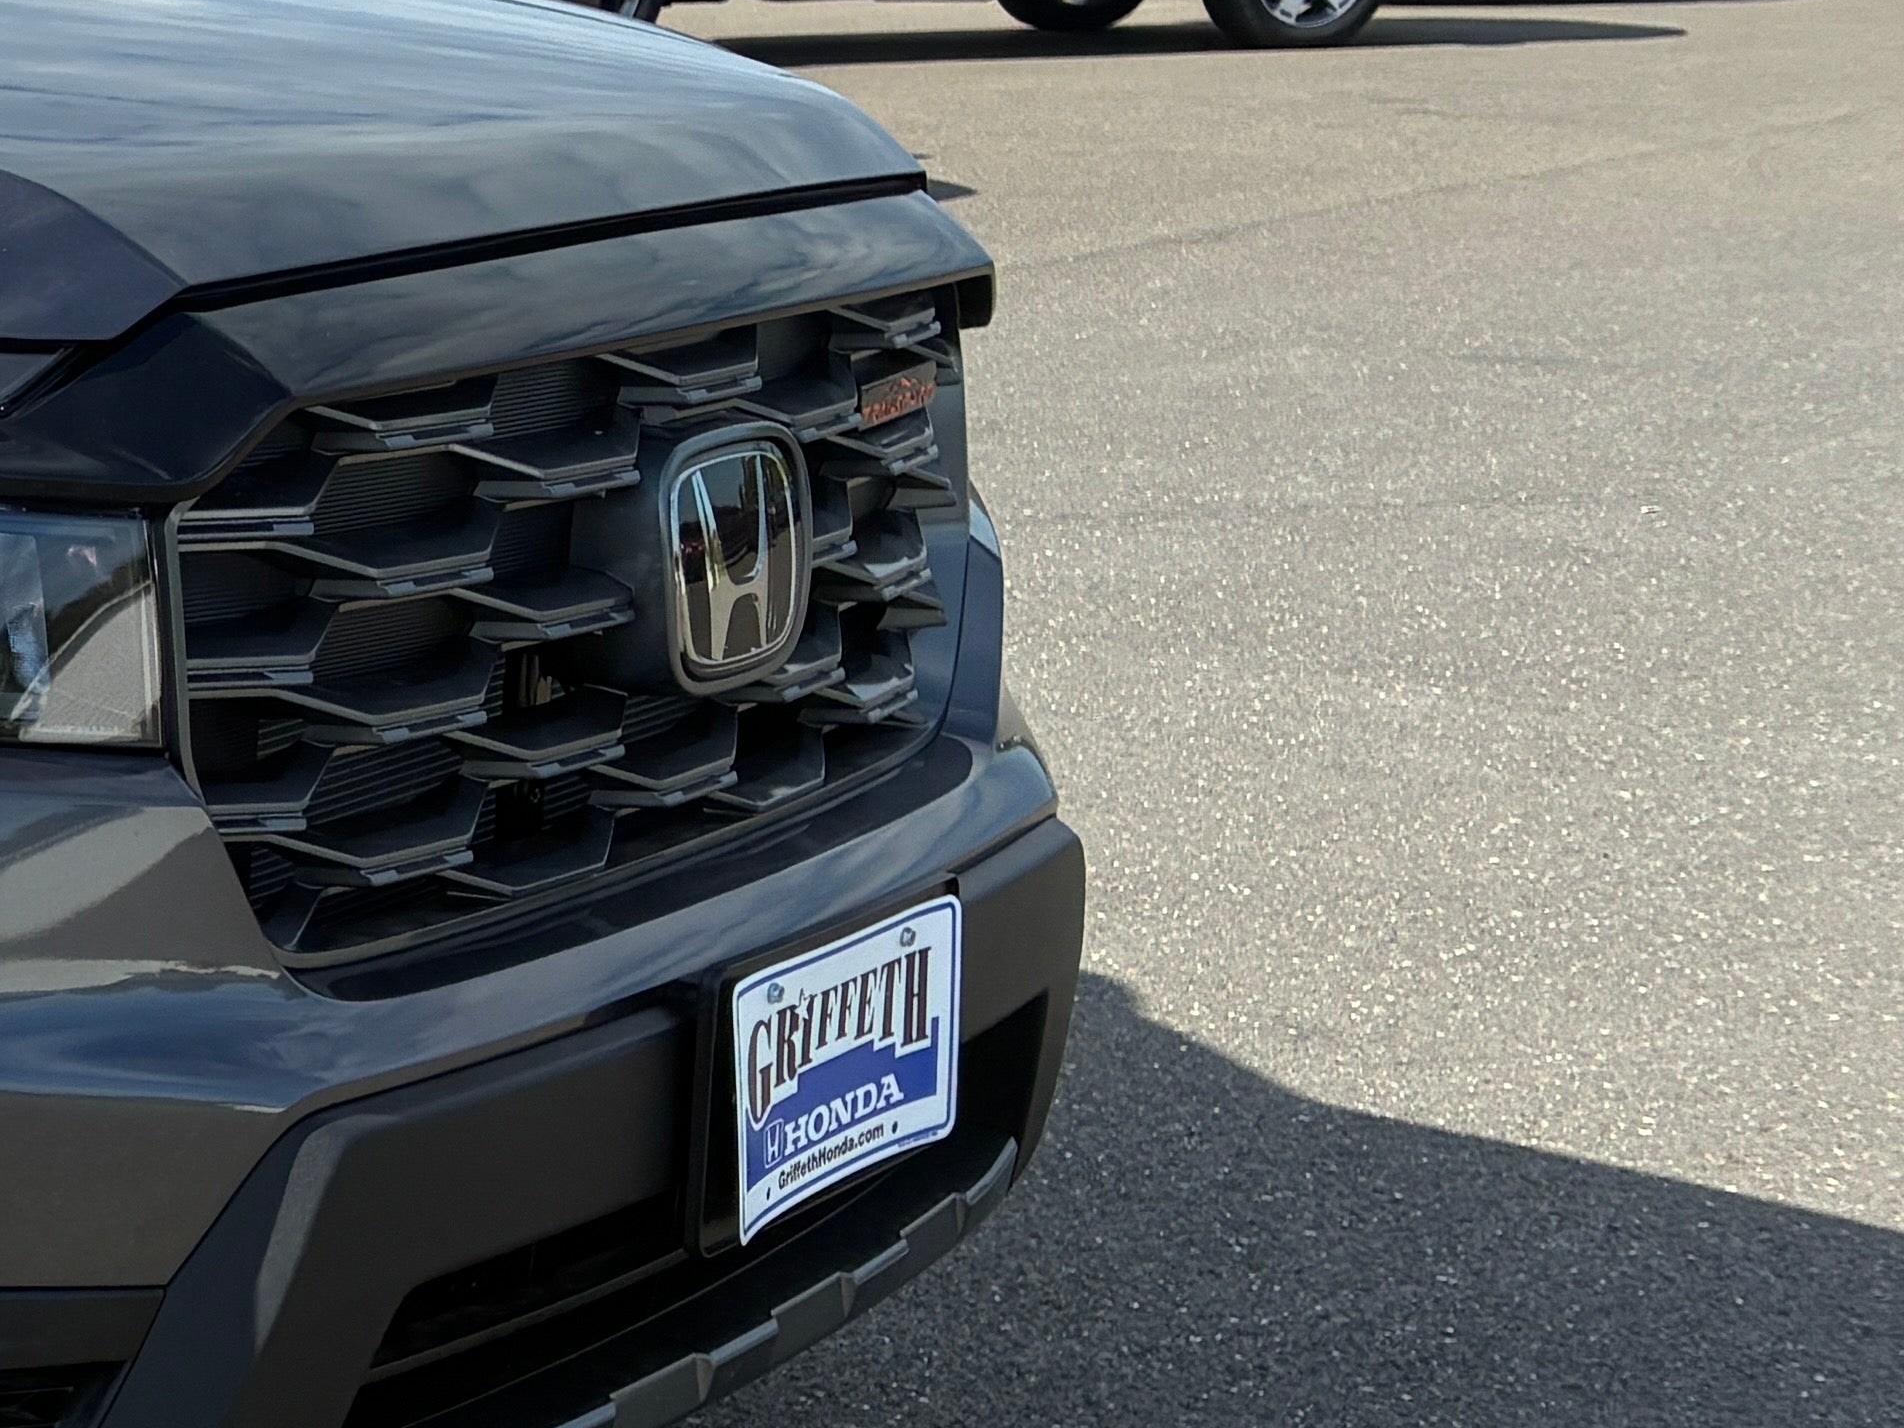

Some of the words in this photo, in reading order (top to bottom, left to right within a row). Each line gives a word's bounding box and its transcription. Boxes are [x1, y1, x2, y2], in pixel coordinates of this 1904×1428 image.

[747, 947, 932, 1124] GRIFFETH
[778, 1120, 885, 1191] GriffethHonda.com
[784, 1073, 904, 1156] HONDA
